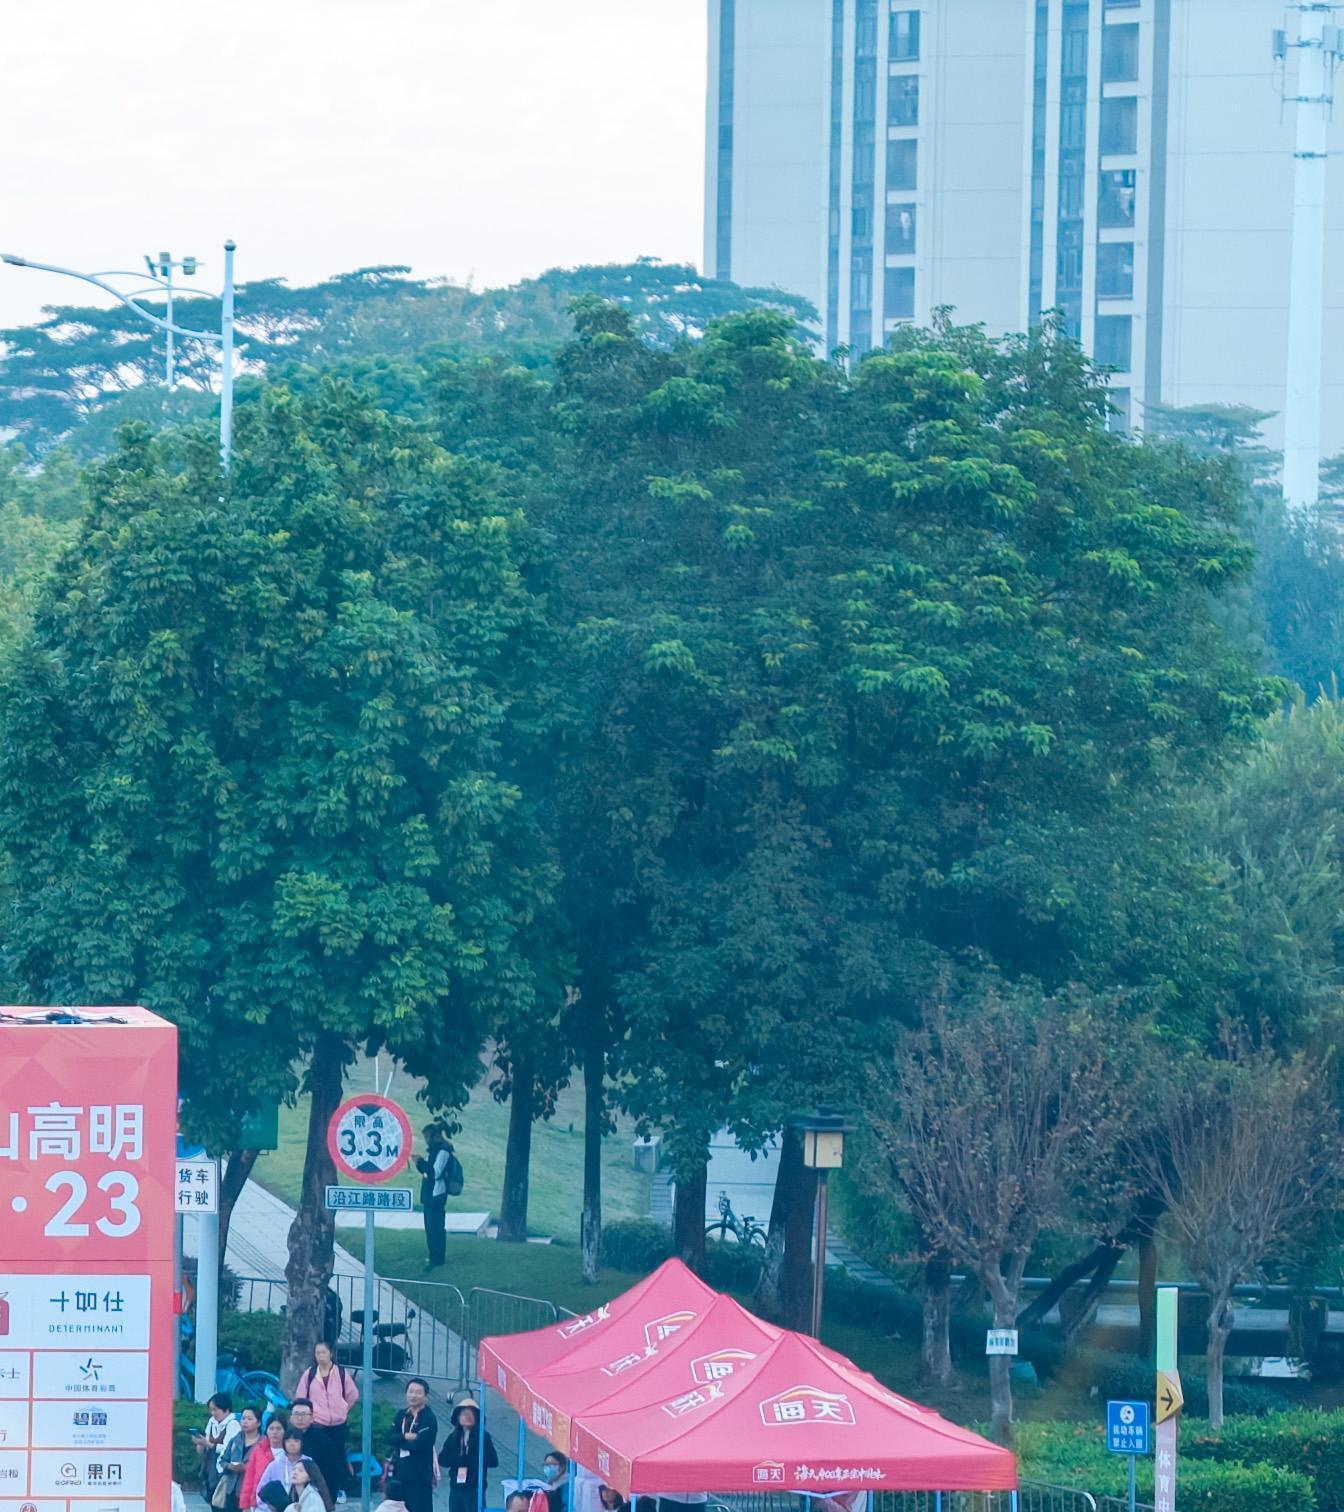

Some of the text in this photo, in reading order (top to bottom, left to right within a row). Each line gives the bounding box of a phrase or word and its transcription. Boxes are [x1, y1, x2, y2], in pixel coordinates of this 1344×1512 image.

[354, 1115, 384, 1128] 限高
[178, 1189, 209, 1206] 行驶
[332, 1191, 406, 1208] 沿江路路段
[49, 1324, 124, 1334] DETERMINANT
[772, 1401, 845, 1422] 海天
[757, 1468, 781, 1481] 海天
